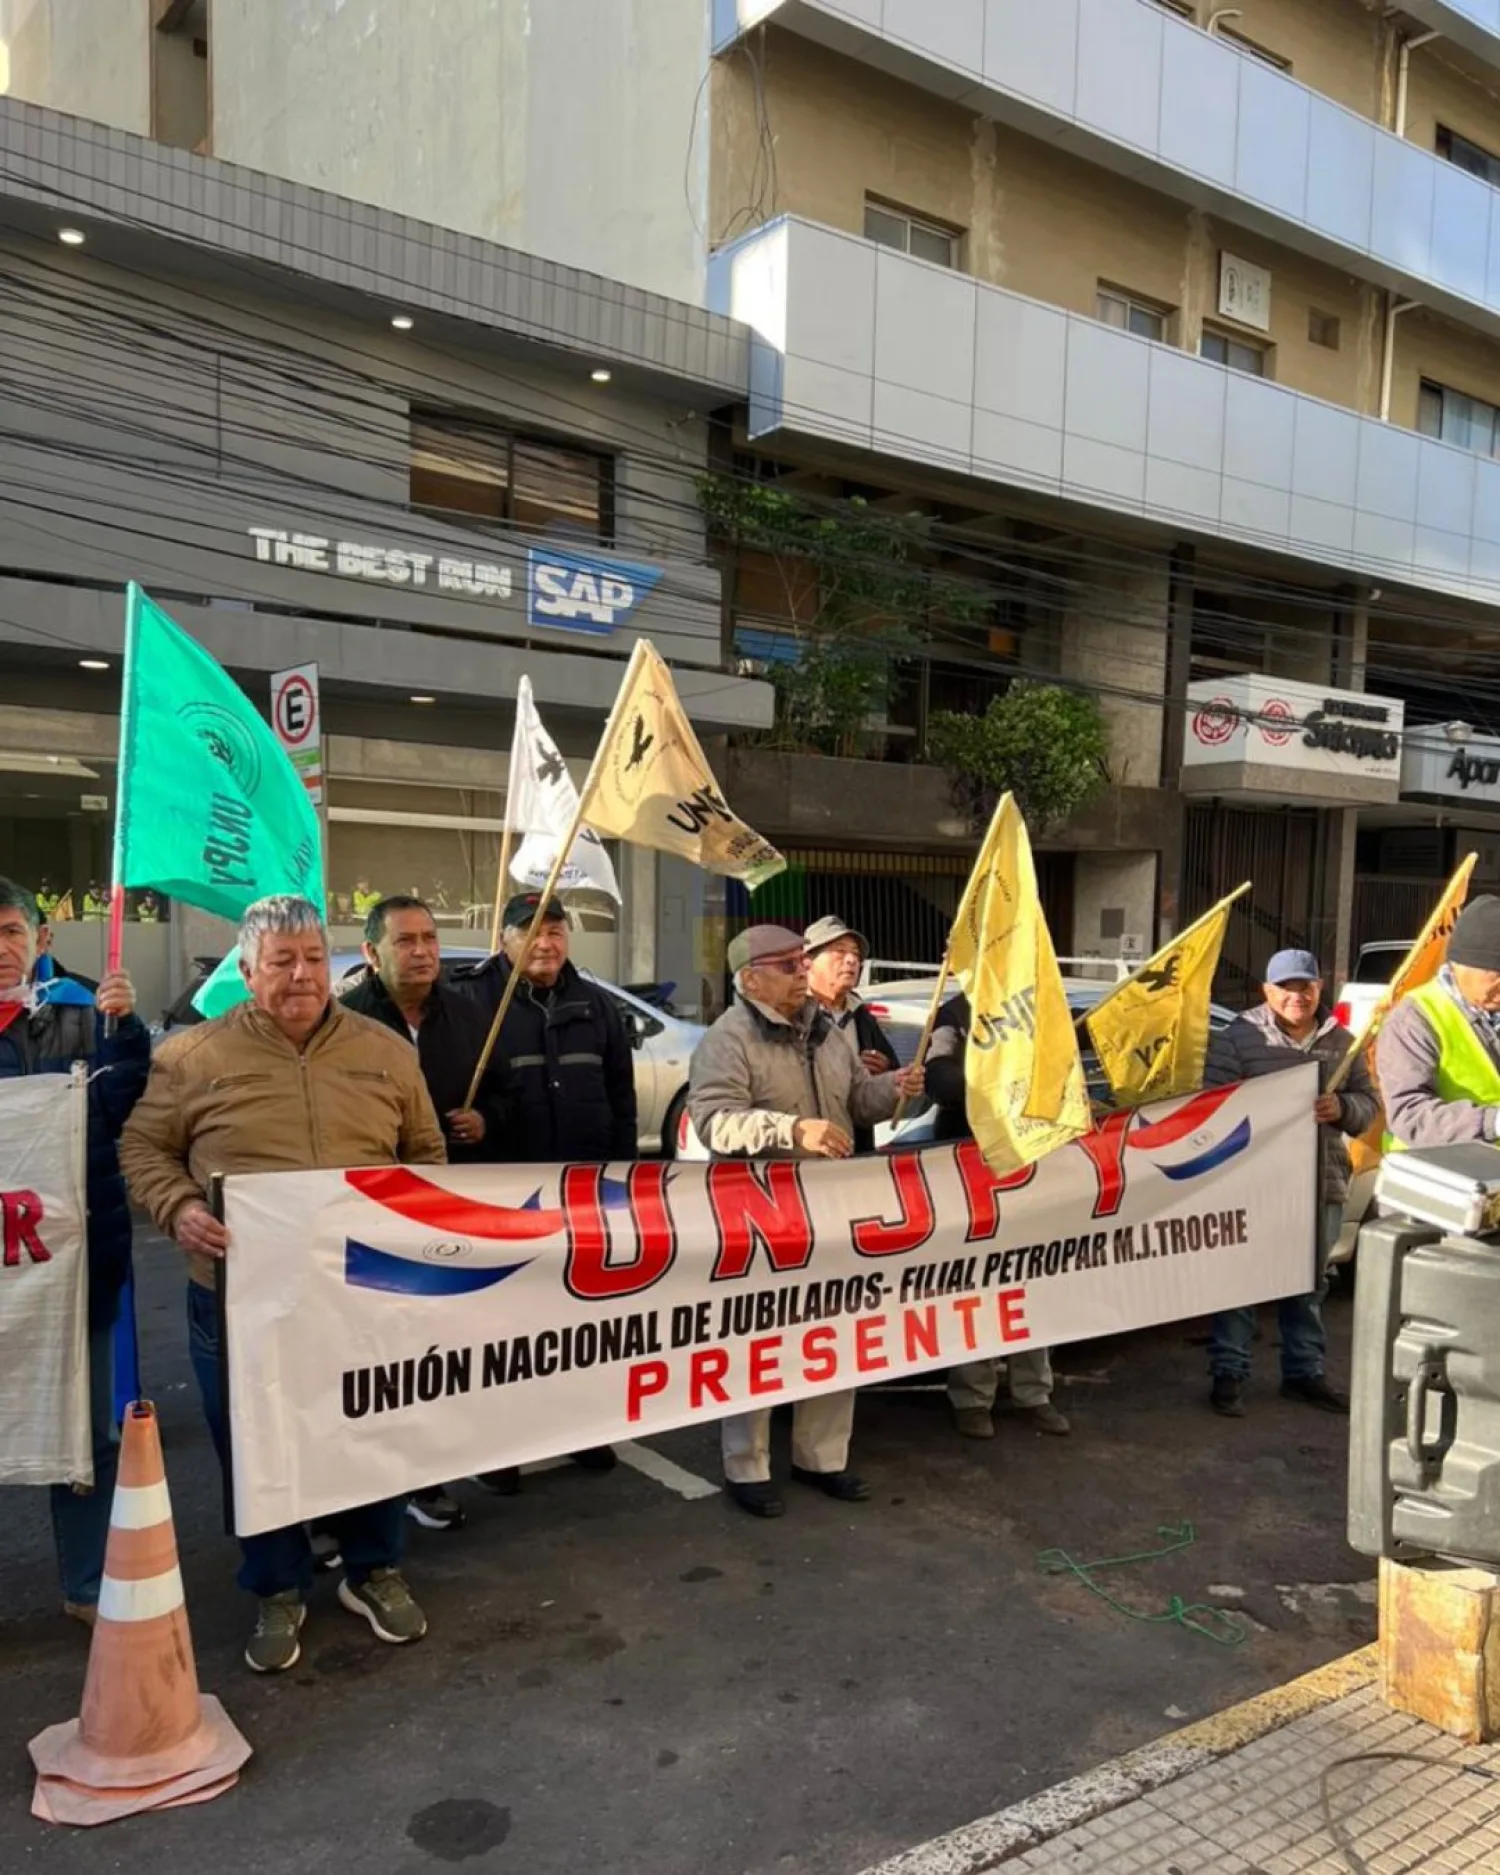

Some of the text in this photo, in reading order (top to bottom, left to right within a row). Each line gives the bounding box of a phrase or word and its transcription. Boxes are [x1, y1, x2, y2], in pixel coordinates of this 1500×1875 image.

[248, 527, 512, 598] THE BEST RUN
[535, 564, 634, 624] SAP
[286, 688, 305, 730] E
[561, 1107, 1139, 1300] UNJPY
[343, 1345, 471, 1419] UNIÓN
[482, 1309, 661, 1388] NACIONAL
[671, 1301, 712, 1350] DE
[717, 1272, 893, 1338] JUBILADOS-
[900, 1247, 976, 1302] FILIAL
[982, 1232, 1108, 1288] PETROPAR
[627, 1288, 1030, 1423] PRESENTE
